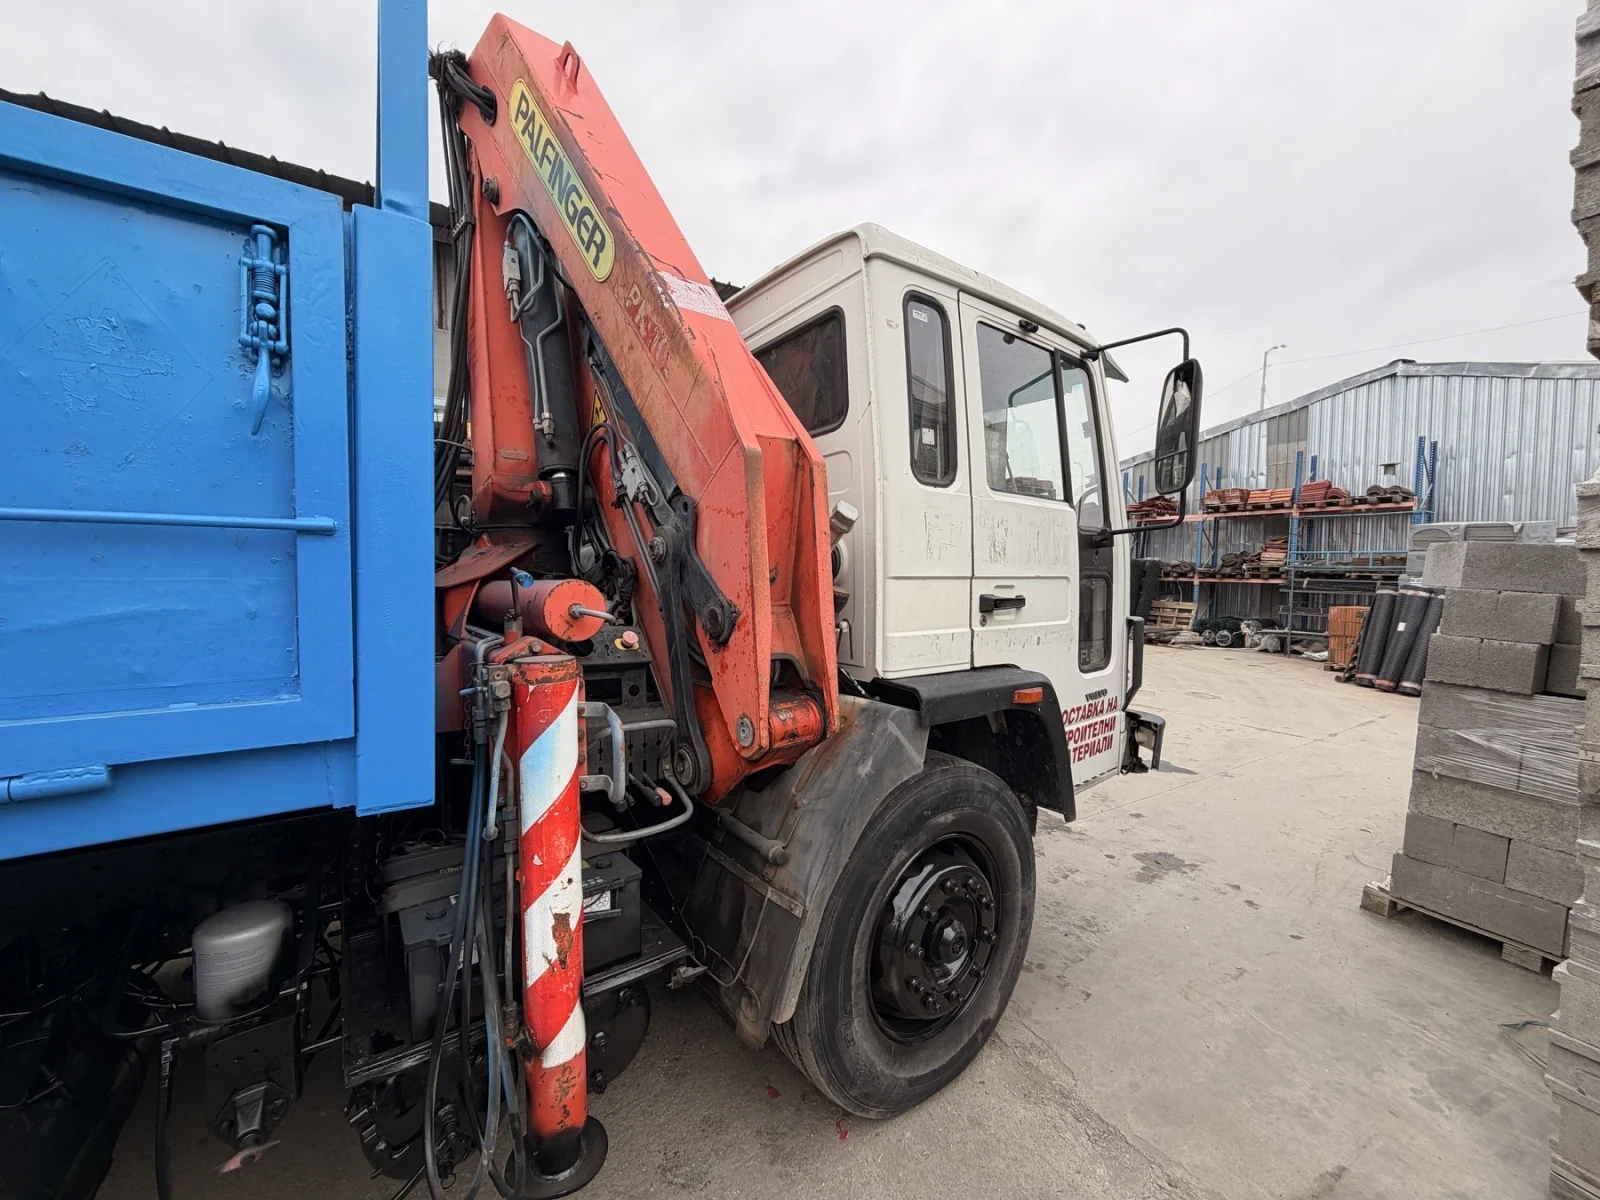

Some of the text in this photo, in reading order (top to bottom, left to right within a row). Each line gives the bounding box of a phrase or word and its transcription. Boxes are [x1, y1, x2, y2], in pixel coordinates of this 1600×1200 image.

[515, 90, 605, 269] PALFINGER
[1062, 695, 1118, 725] ОСТАВКА НА
[1085, 689, 1108, 702] VOLVO
[1066, 716, 1116, 746] РОИТЕЛНИ
[1069, 734, 1113, 764] ТЕРИАЛИ
